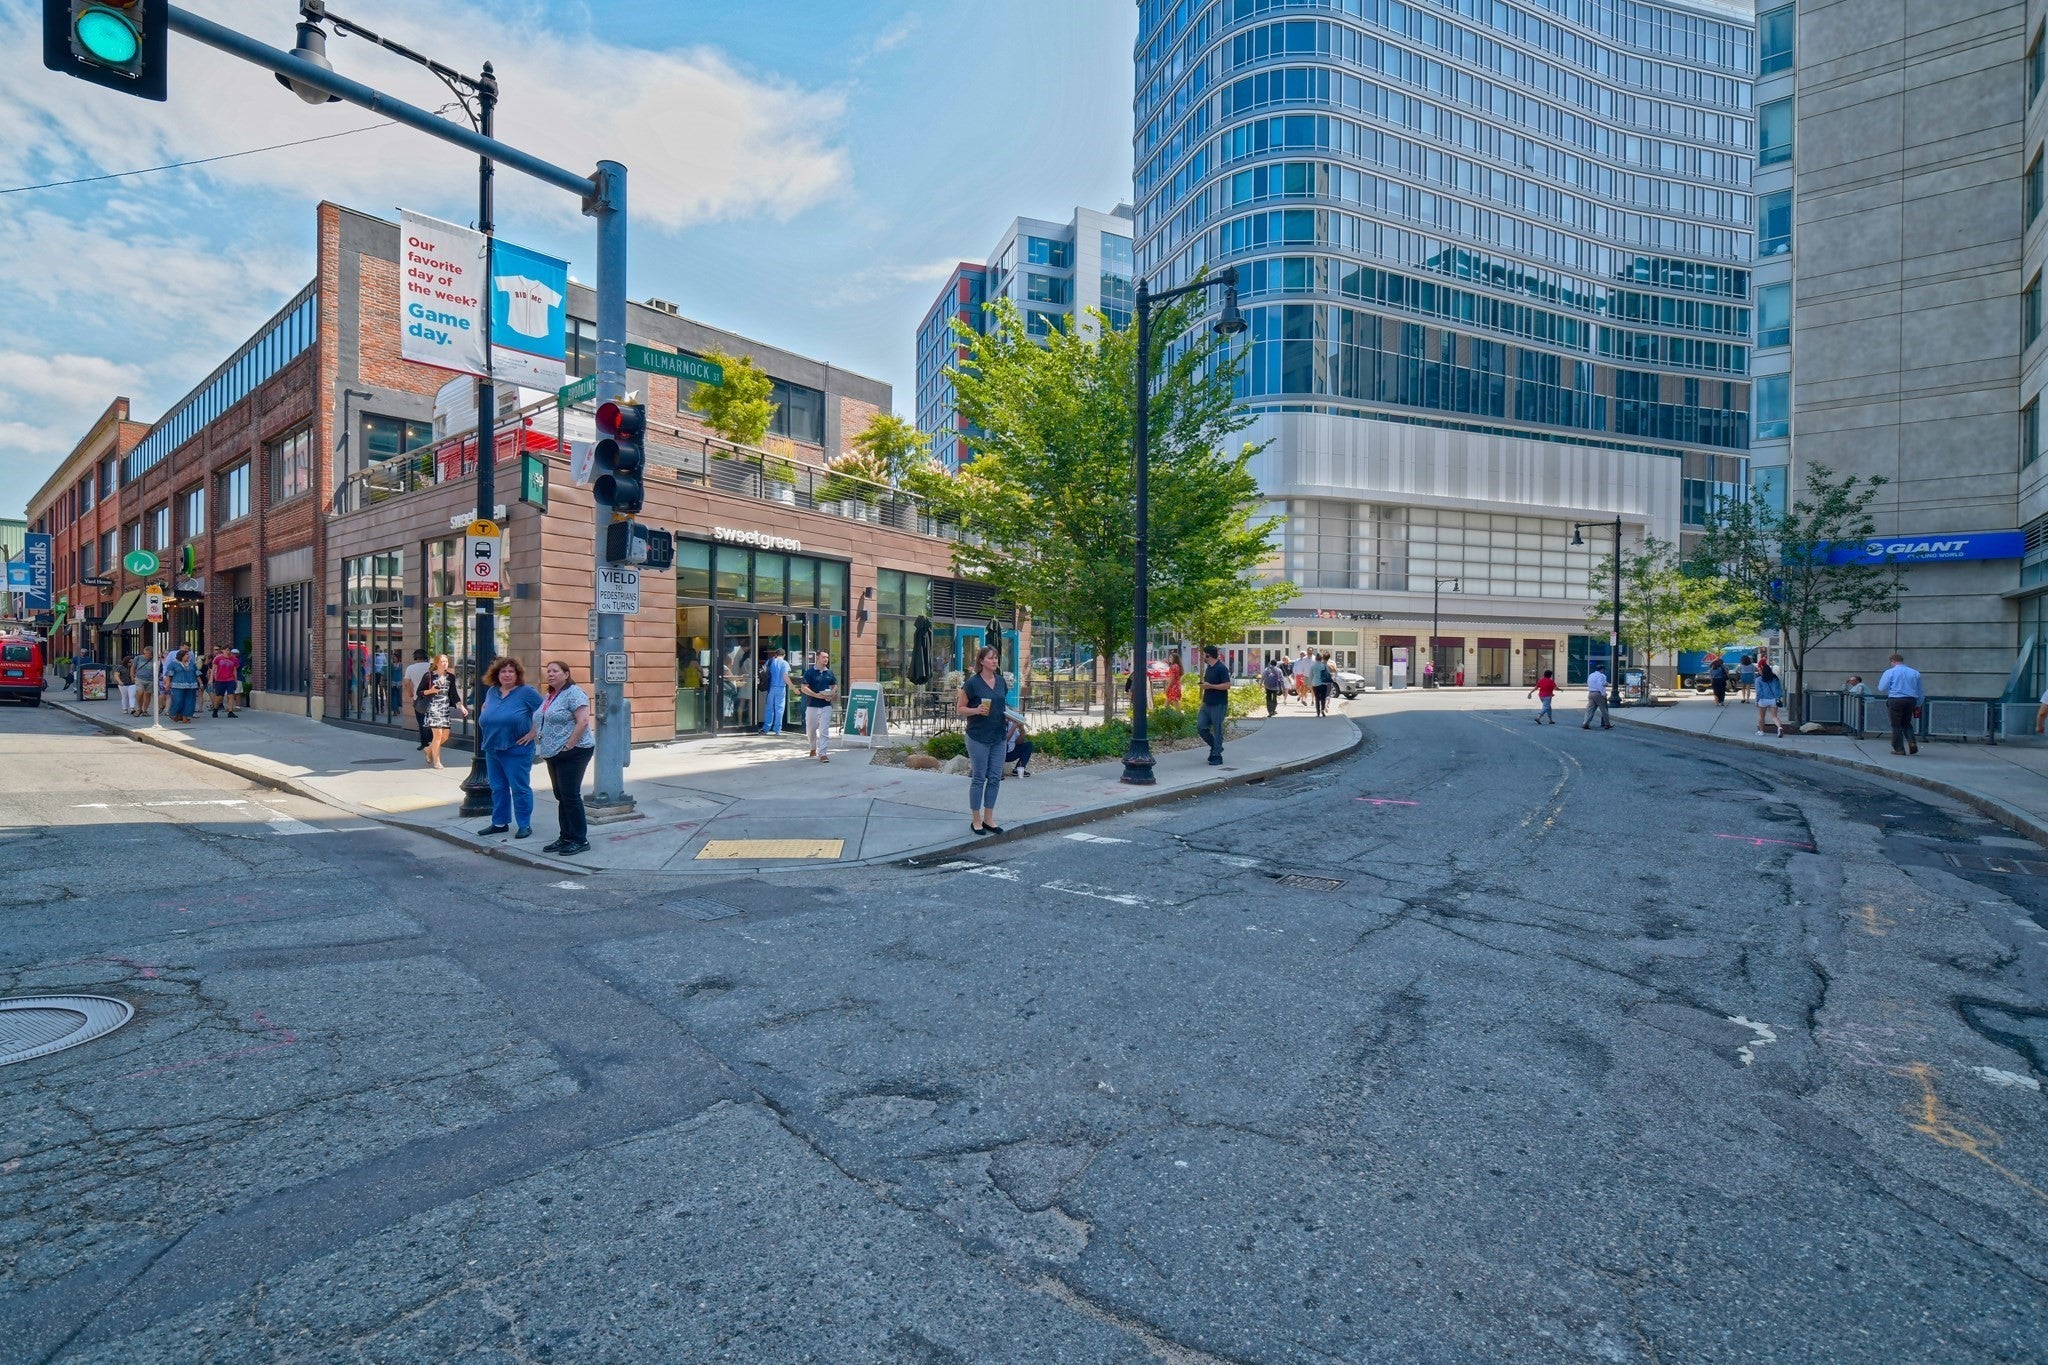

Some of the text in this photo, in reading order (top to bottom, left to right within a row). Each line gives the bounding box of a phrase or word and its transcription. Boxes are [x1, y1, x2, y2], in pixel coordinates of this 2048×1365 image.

[408, 237, 435, 252] Our
[408, 252, 462, 274] favorite
[408, 268, 453, 286] day of
[408, 282, 477, 307] the week?
[408, 303, 470, 330] Game
[408, 323, 452, 345] day.
[643, 351, 720, 382] KILMARNOCK ST
[568, 378, 595, 400] BROOKLINE
[713, 526, 801, 552] sweetgreen
[1886, 540, 1969, 553] GIANT
[30, 541, 47, 601] Marshalls
[602, 571, 637, 584] YIELD
[600, 590, 637, 602] PEDESTRIANS
[612, 601, 636, 611] TURNS
